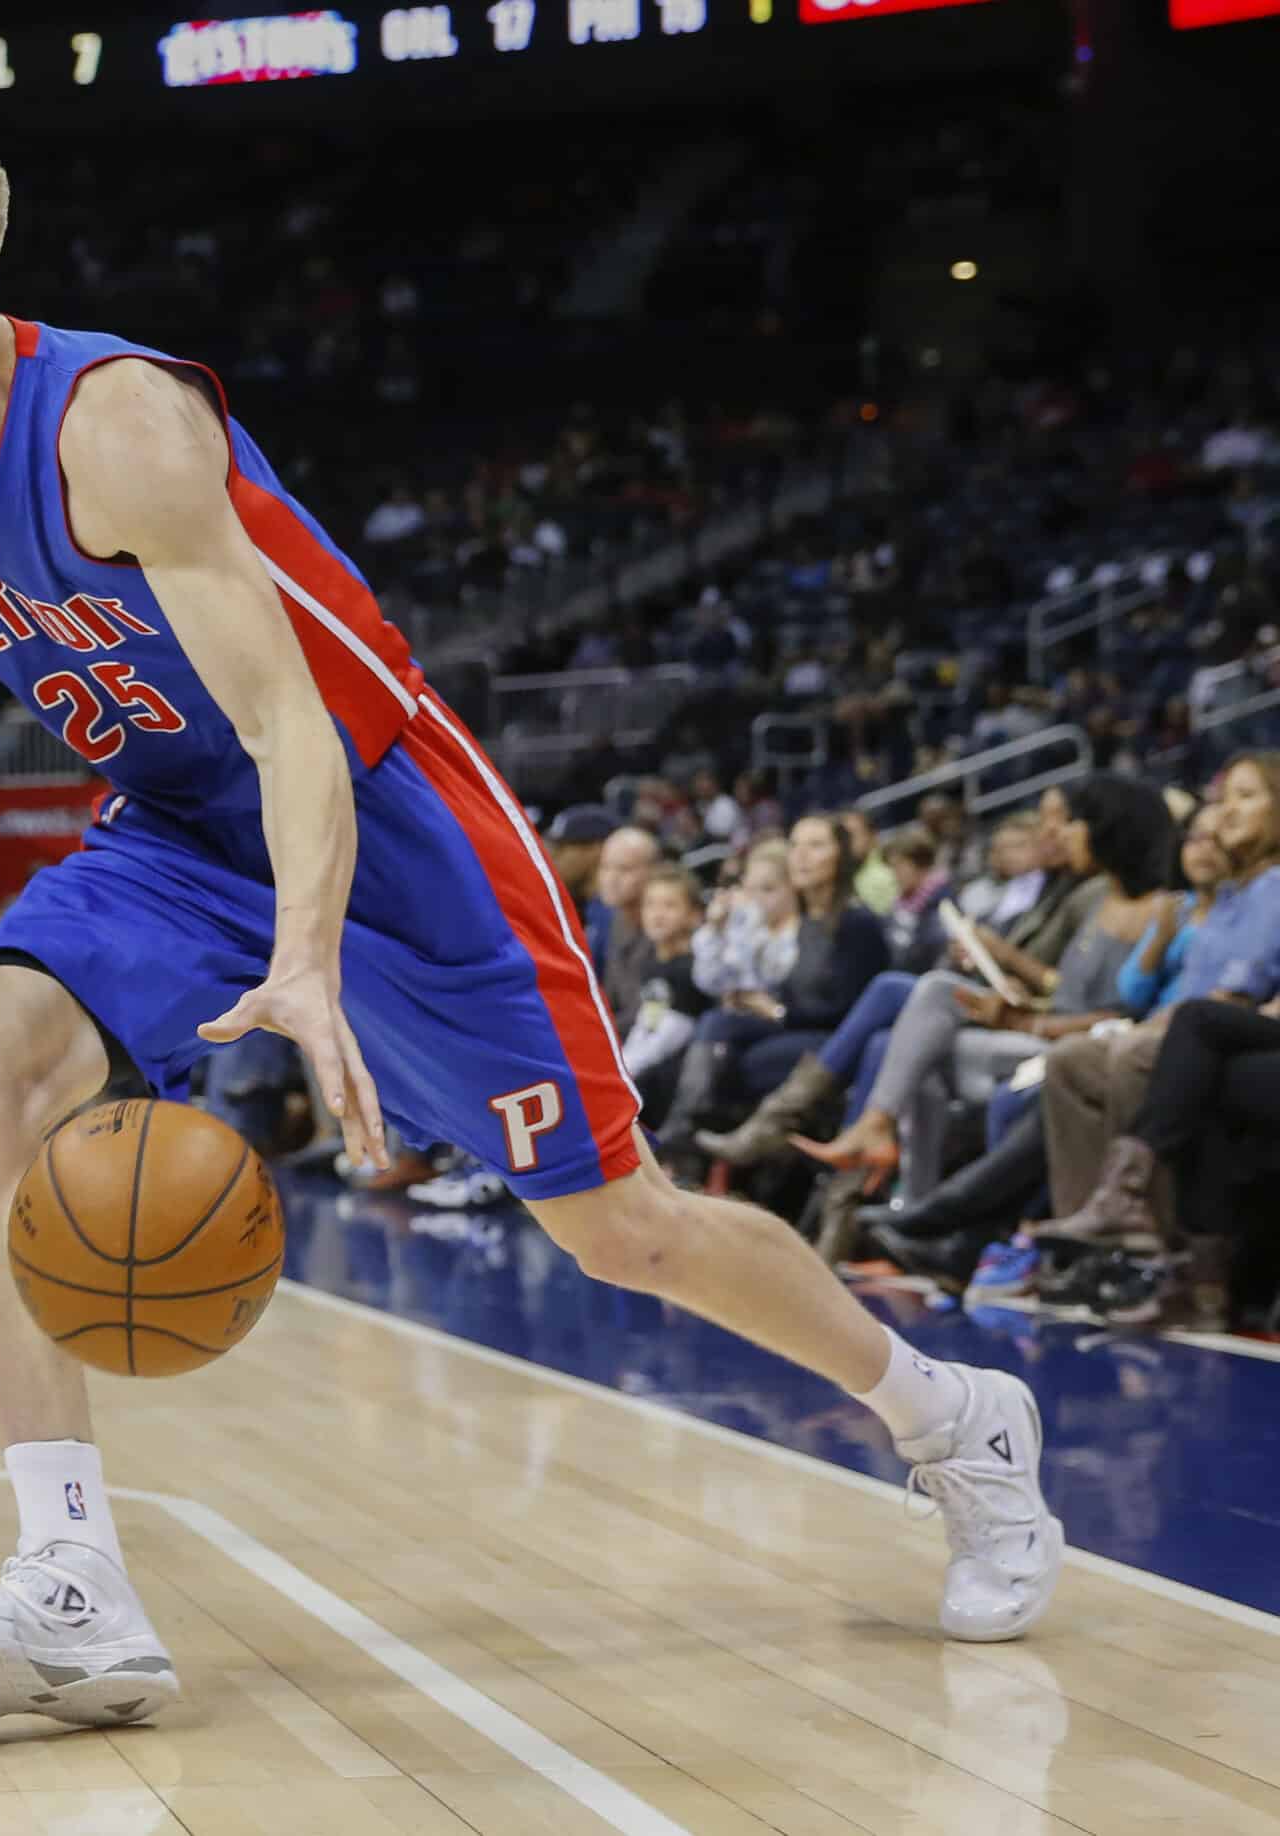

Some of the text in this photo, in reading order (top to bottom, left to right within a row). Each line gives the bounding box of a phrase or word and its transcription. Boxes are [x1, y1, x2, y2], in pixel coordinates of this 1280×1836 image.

[71, 33, 101, 84] 7
[33, 661, 186, 763] 25
[487, 1079, 564, 1173] P
